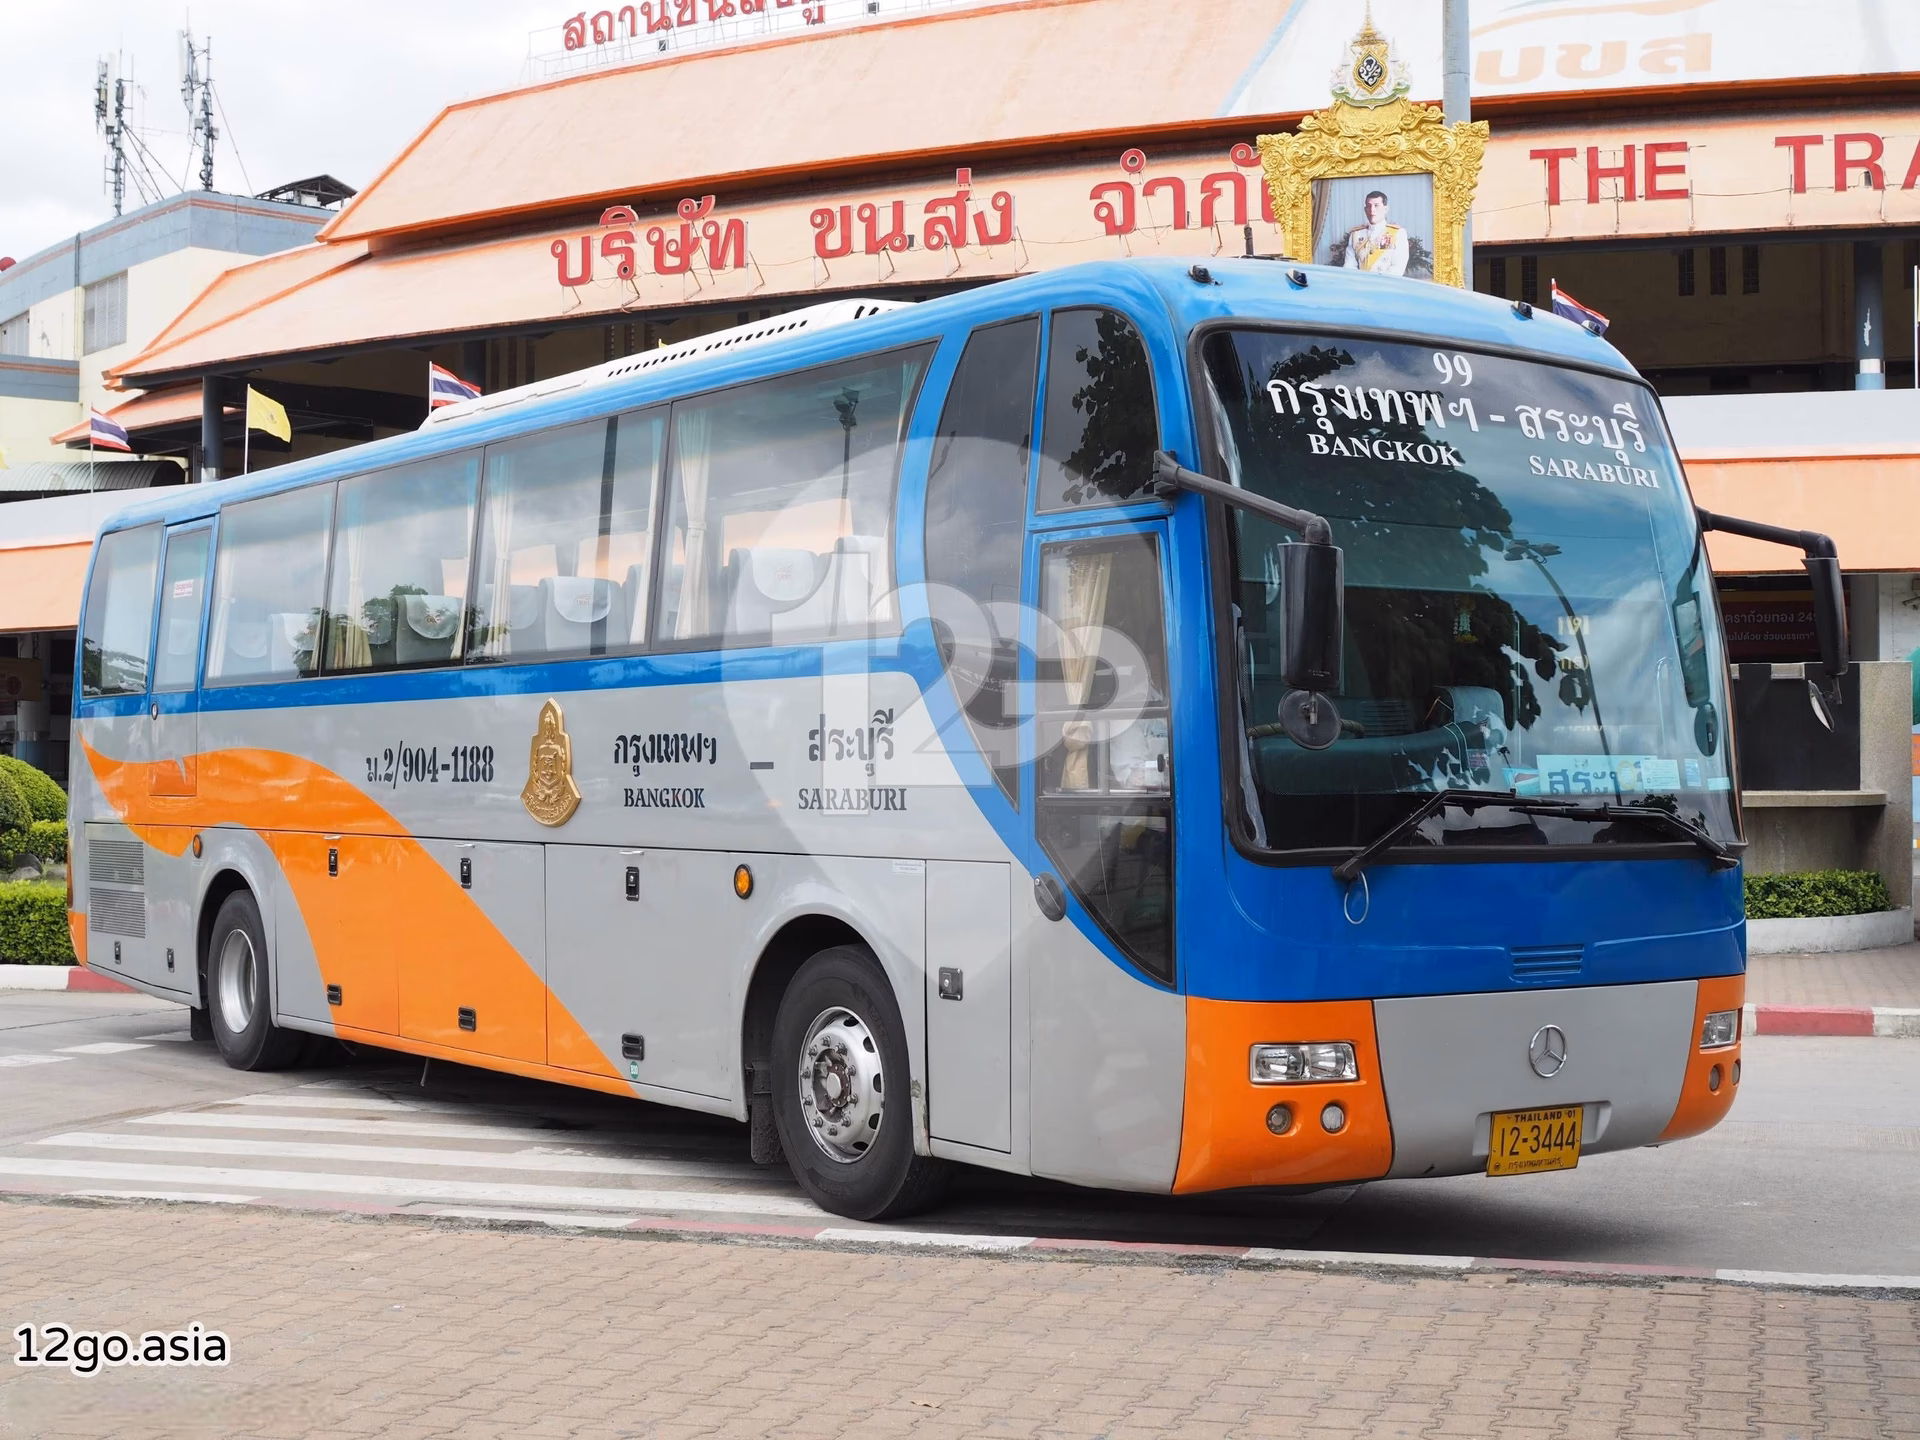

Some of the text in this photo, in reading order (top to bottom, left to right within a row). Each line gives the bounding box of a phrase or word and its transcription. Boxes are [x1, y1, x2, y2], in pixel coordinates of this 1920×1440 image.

[1529, 141, 1691, 206] THE
[551, 195, 746, 287] บริษัท
[810, 168, 1013, 259] ขนส่ง
[1433, 352, 1473, 387] 99
[1266, 379, 1480, 434] กรุงเทพฯ
[1514, 402, 1647, 466] สระบุรี
[1306, 433, 1660, 489] BANGKOK SARABURI
[366, 740, 495, 790] ม.2/904-1188
[614, 733, 717, 777] กรุงเทพฯ
[808, 708, 894, 777] สระบุรี
[623, 787, 908, 811] BANGKOK SARABURI
[1500, 1121, 1577, 1157] 12-3444
[1514, 1110, 1562, 1123] THAILAND
